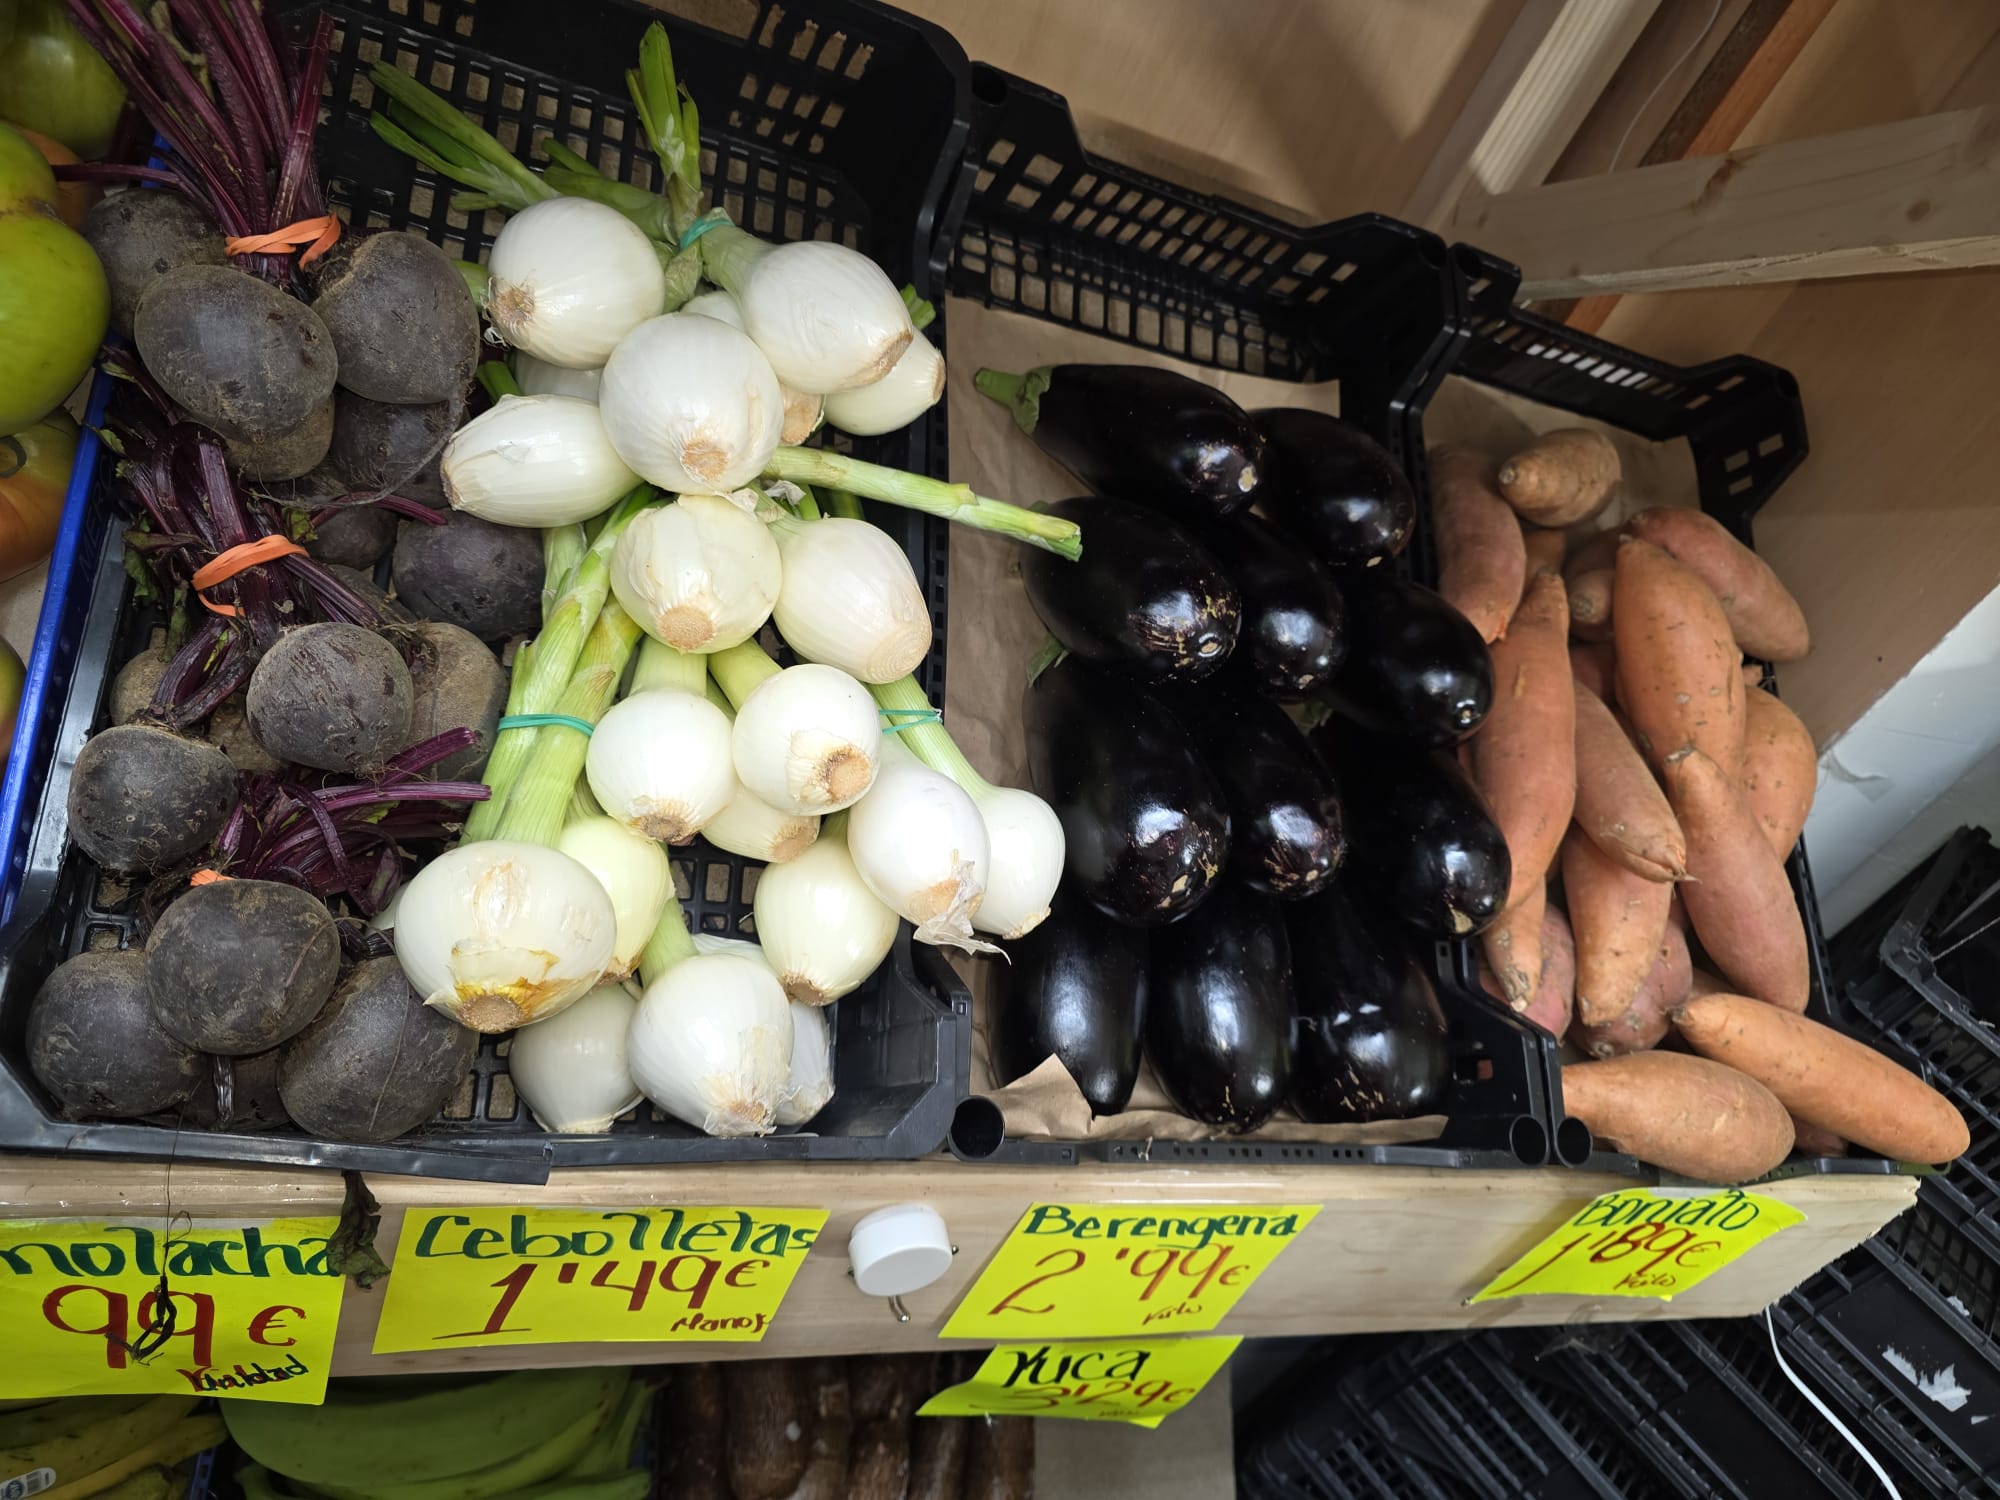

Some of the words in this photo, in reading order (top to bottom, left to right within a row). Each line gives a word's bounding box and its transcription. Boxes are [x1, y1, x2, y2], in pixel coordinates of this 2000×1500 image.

[1023, 1205, 1298, 1249] Berengena
[1573, 1188, 1760, 1231] Boniato
[415, 1209, 818, 1258] Cebolletas
[1001, 1346, 1151, 1388] Yuca
